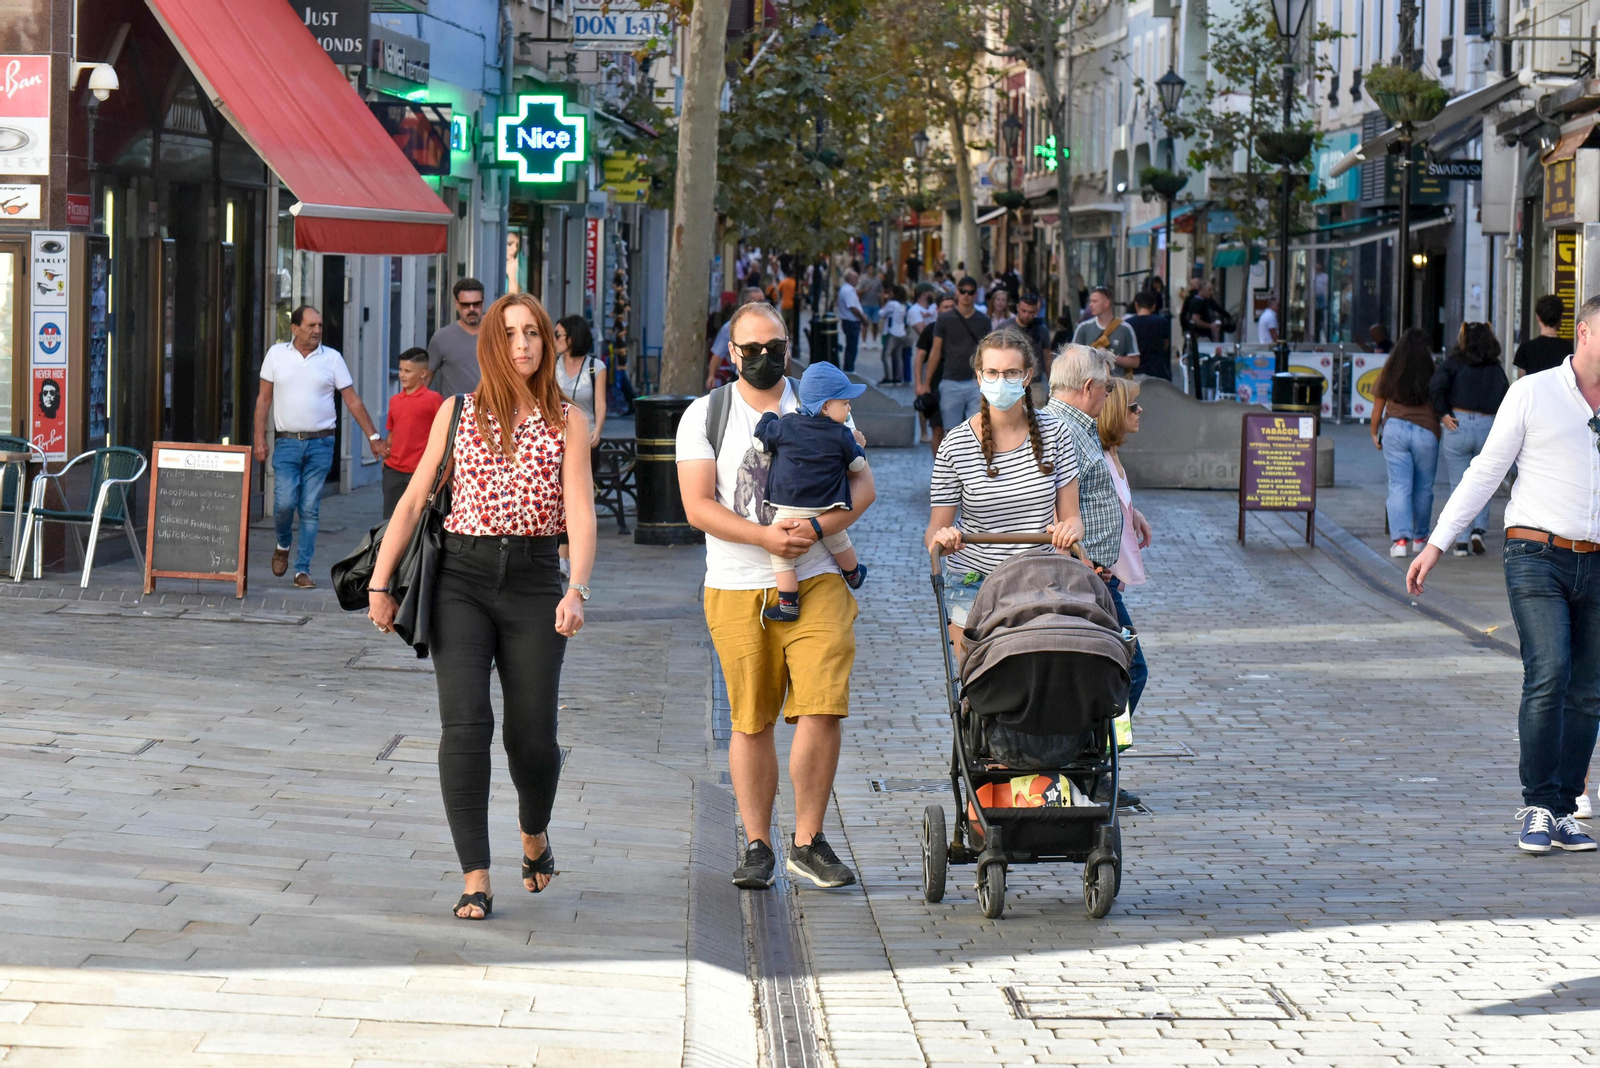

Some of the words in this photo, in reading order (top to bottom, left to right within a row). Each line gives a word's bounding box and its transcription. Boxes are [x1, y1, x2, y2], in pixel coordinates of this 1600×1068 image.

[304, 6, 338, 26] JUST
[575, 16, 617, 34] DON
[317, 37, 362, 52] ONDS
[516, 126, 570, 149] Nice
[35, 370, 51, 378] NEVER
[52, 370, 64, 378] HIDE
